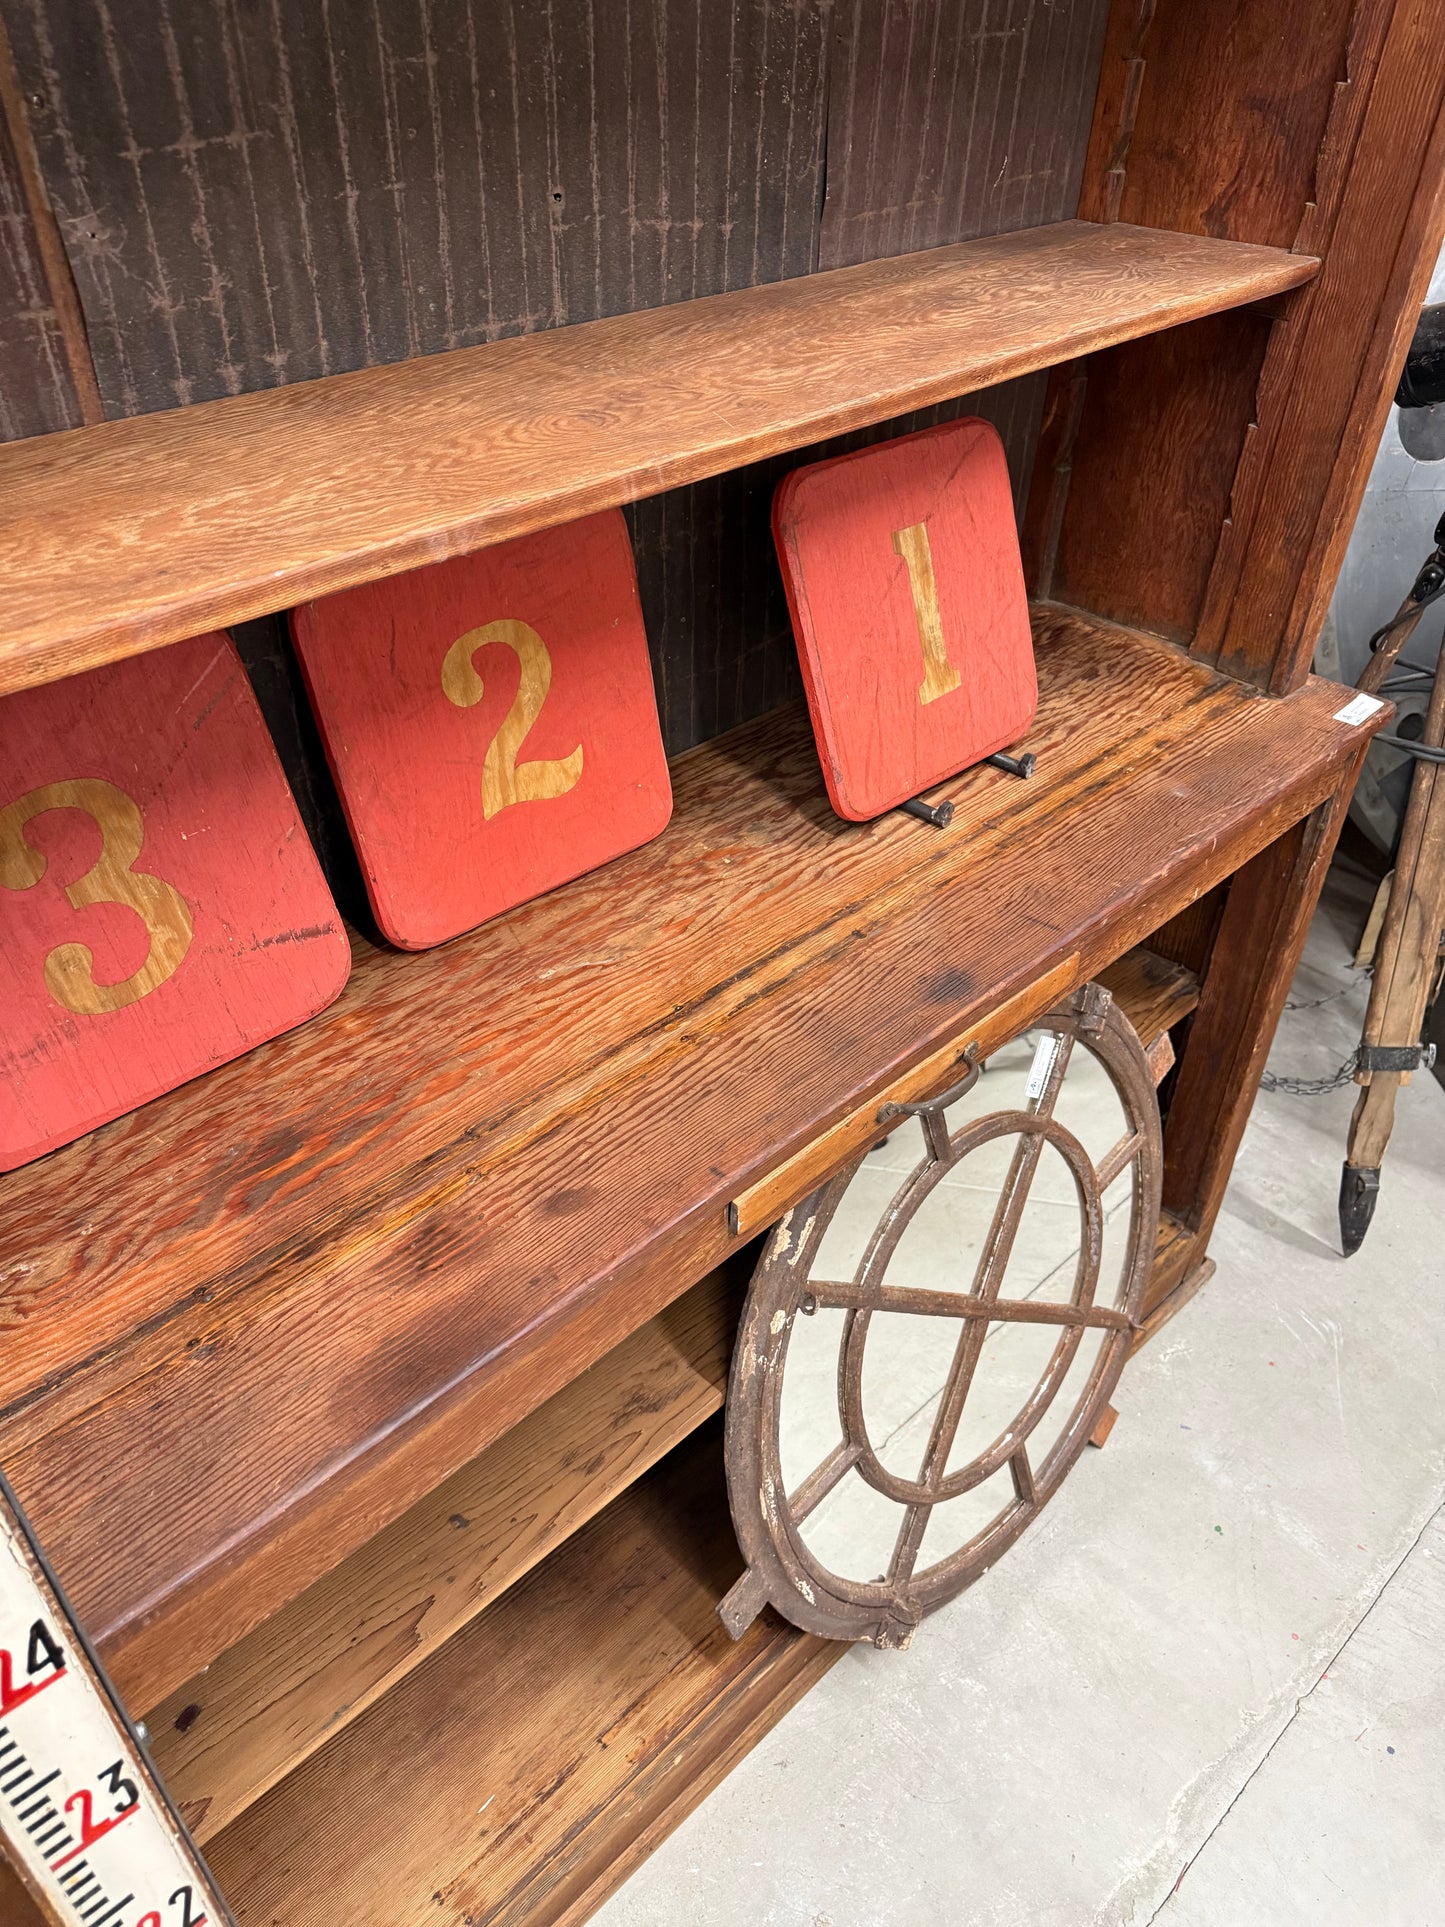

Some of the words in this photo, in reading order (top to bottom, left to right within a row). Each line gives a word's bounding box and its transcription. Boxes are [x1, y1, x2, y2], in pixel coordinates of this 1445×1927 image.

[891, 521, 962, 706] 1
[441, 618, 584, 821] 2
[0, 777, 194, 1015] 3
[64, 1758, 139, 1845] 23
